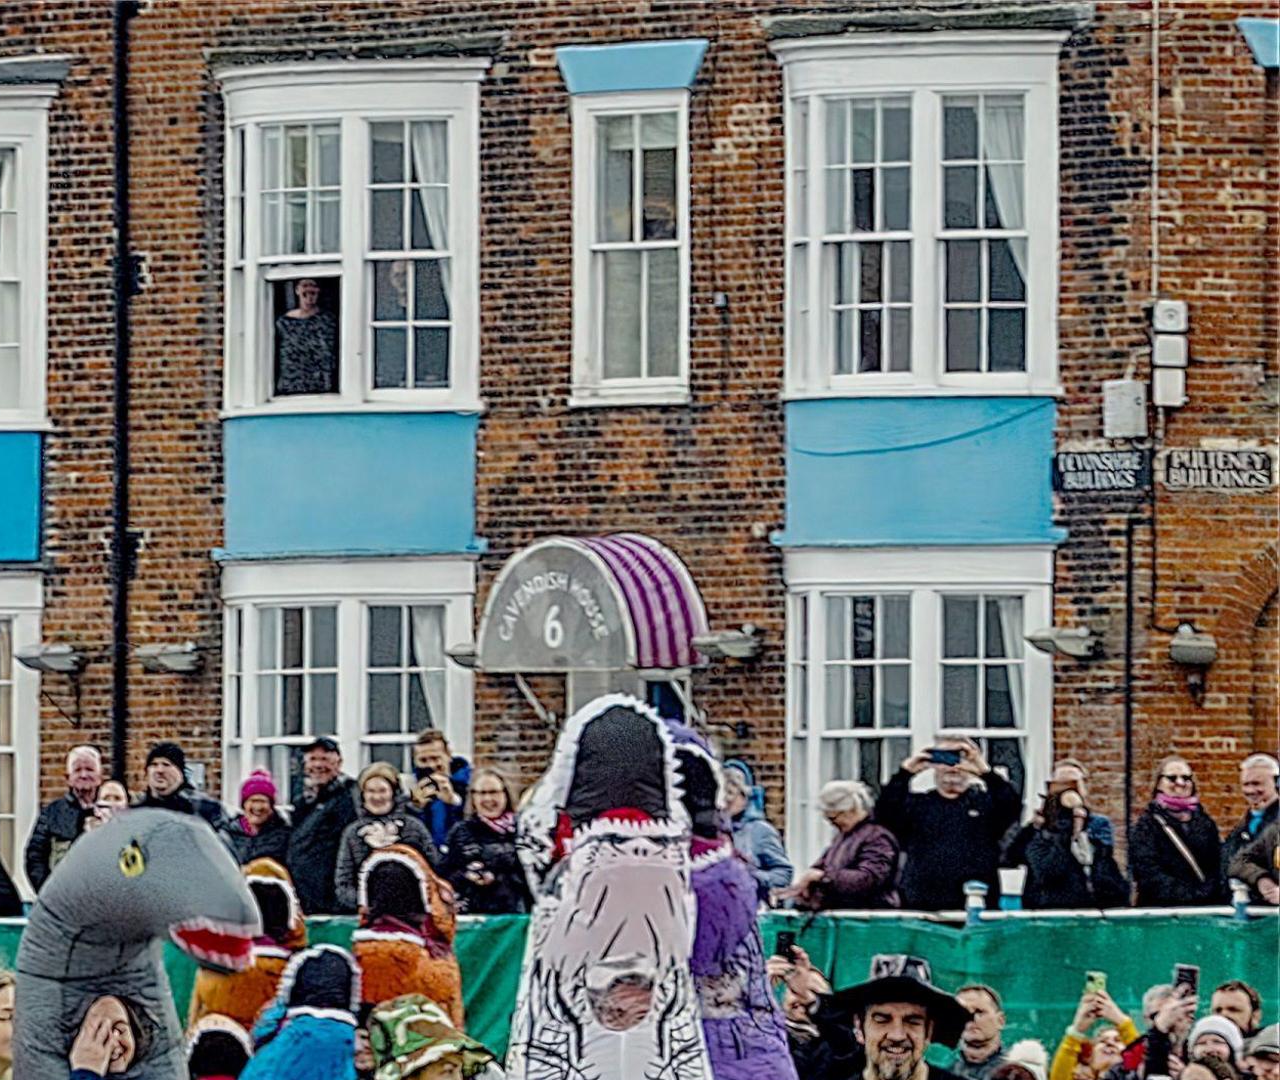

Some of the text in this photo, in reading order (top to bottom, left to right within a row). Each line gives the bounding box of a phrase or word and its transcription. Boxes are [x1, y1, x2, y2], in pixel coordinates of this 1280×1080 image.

[1171, 450, 1270, 470] PULTENEY
[1169, 468, 1270, 488] BUILDINGS
[499, 571, 609, 641] CAVENDISH HOUSE
[544, 605, 563, 648] 6
